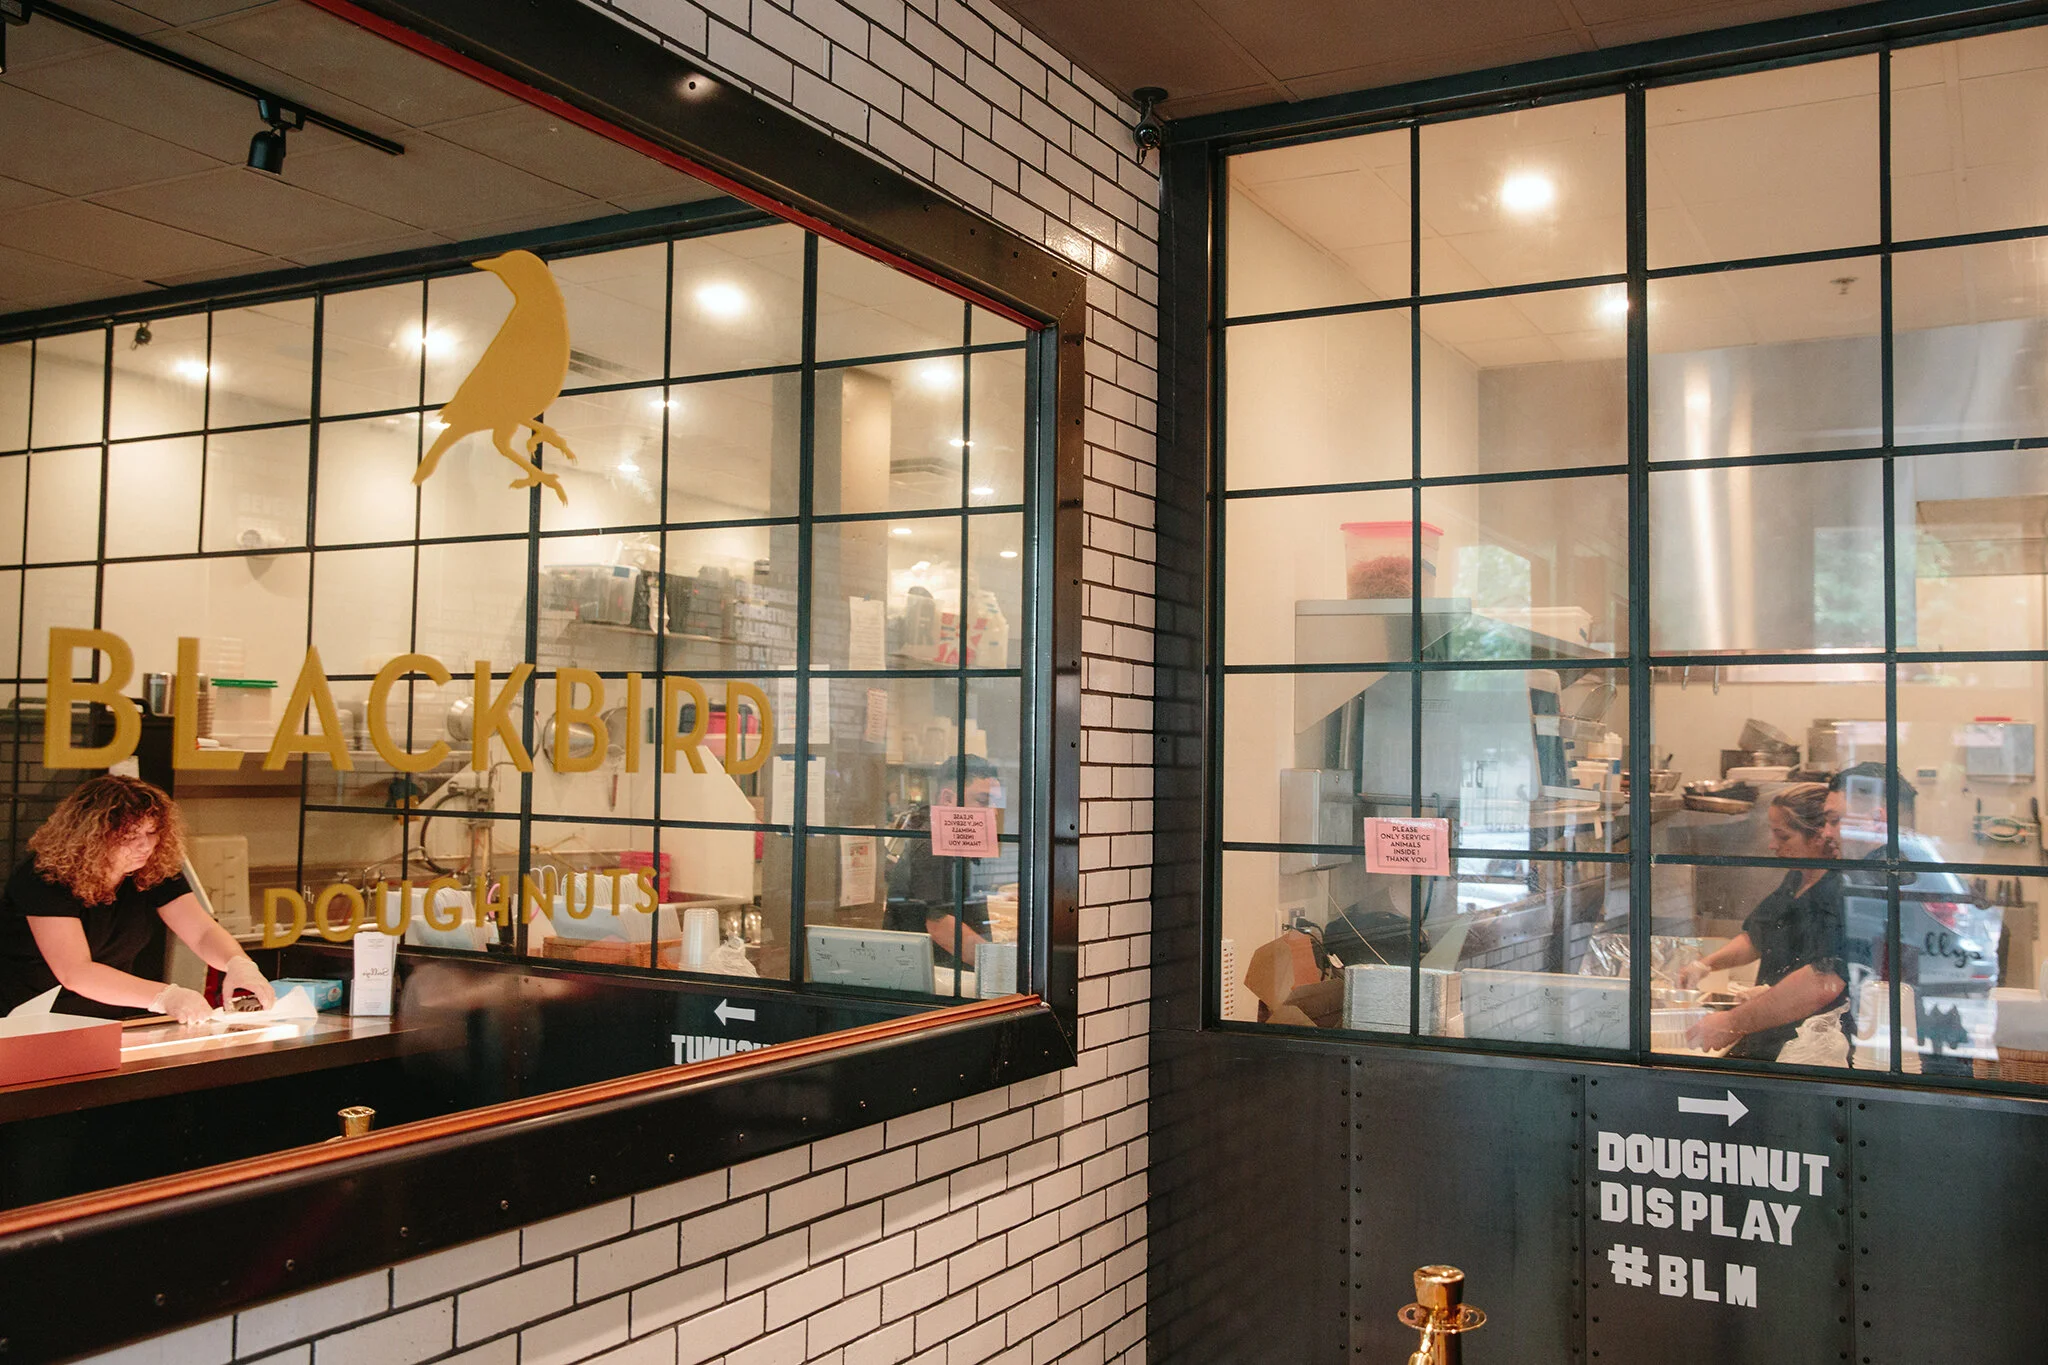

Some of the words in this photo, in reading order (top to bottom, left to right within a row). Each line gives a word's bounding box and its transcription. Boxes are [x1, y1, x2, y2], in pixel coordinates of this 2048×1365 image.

[43, 626, 774, 774] BLACKBIRD
[1385, 855, 1410, 863] THANK
[1411, 856, 1427, 864] YOU
[1401, 833, 1431, 841] SERVICE
[262, 866, 659, 949] DOUGHNUTS
[1597, 1130, 1830, 1197] DOUGHNUT
[1600, 1180, 1802, 1247] DISPLAY
